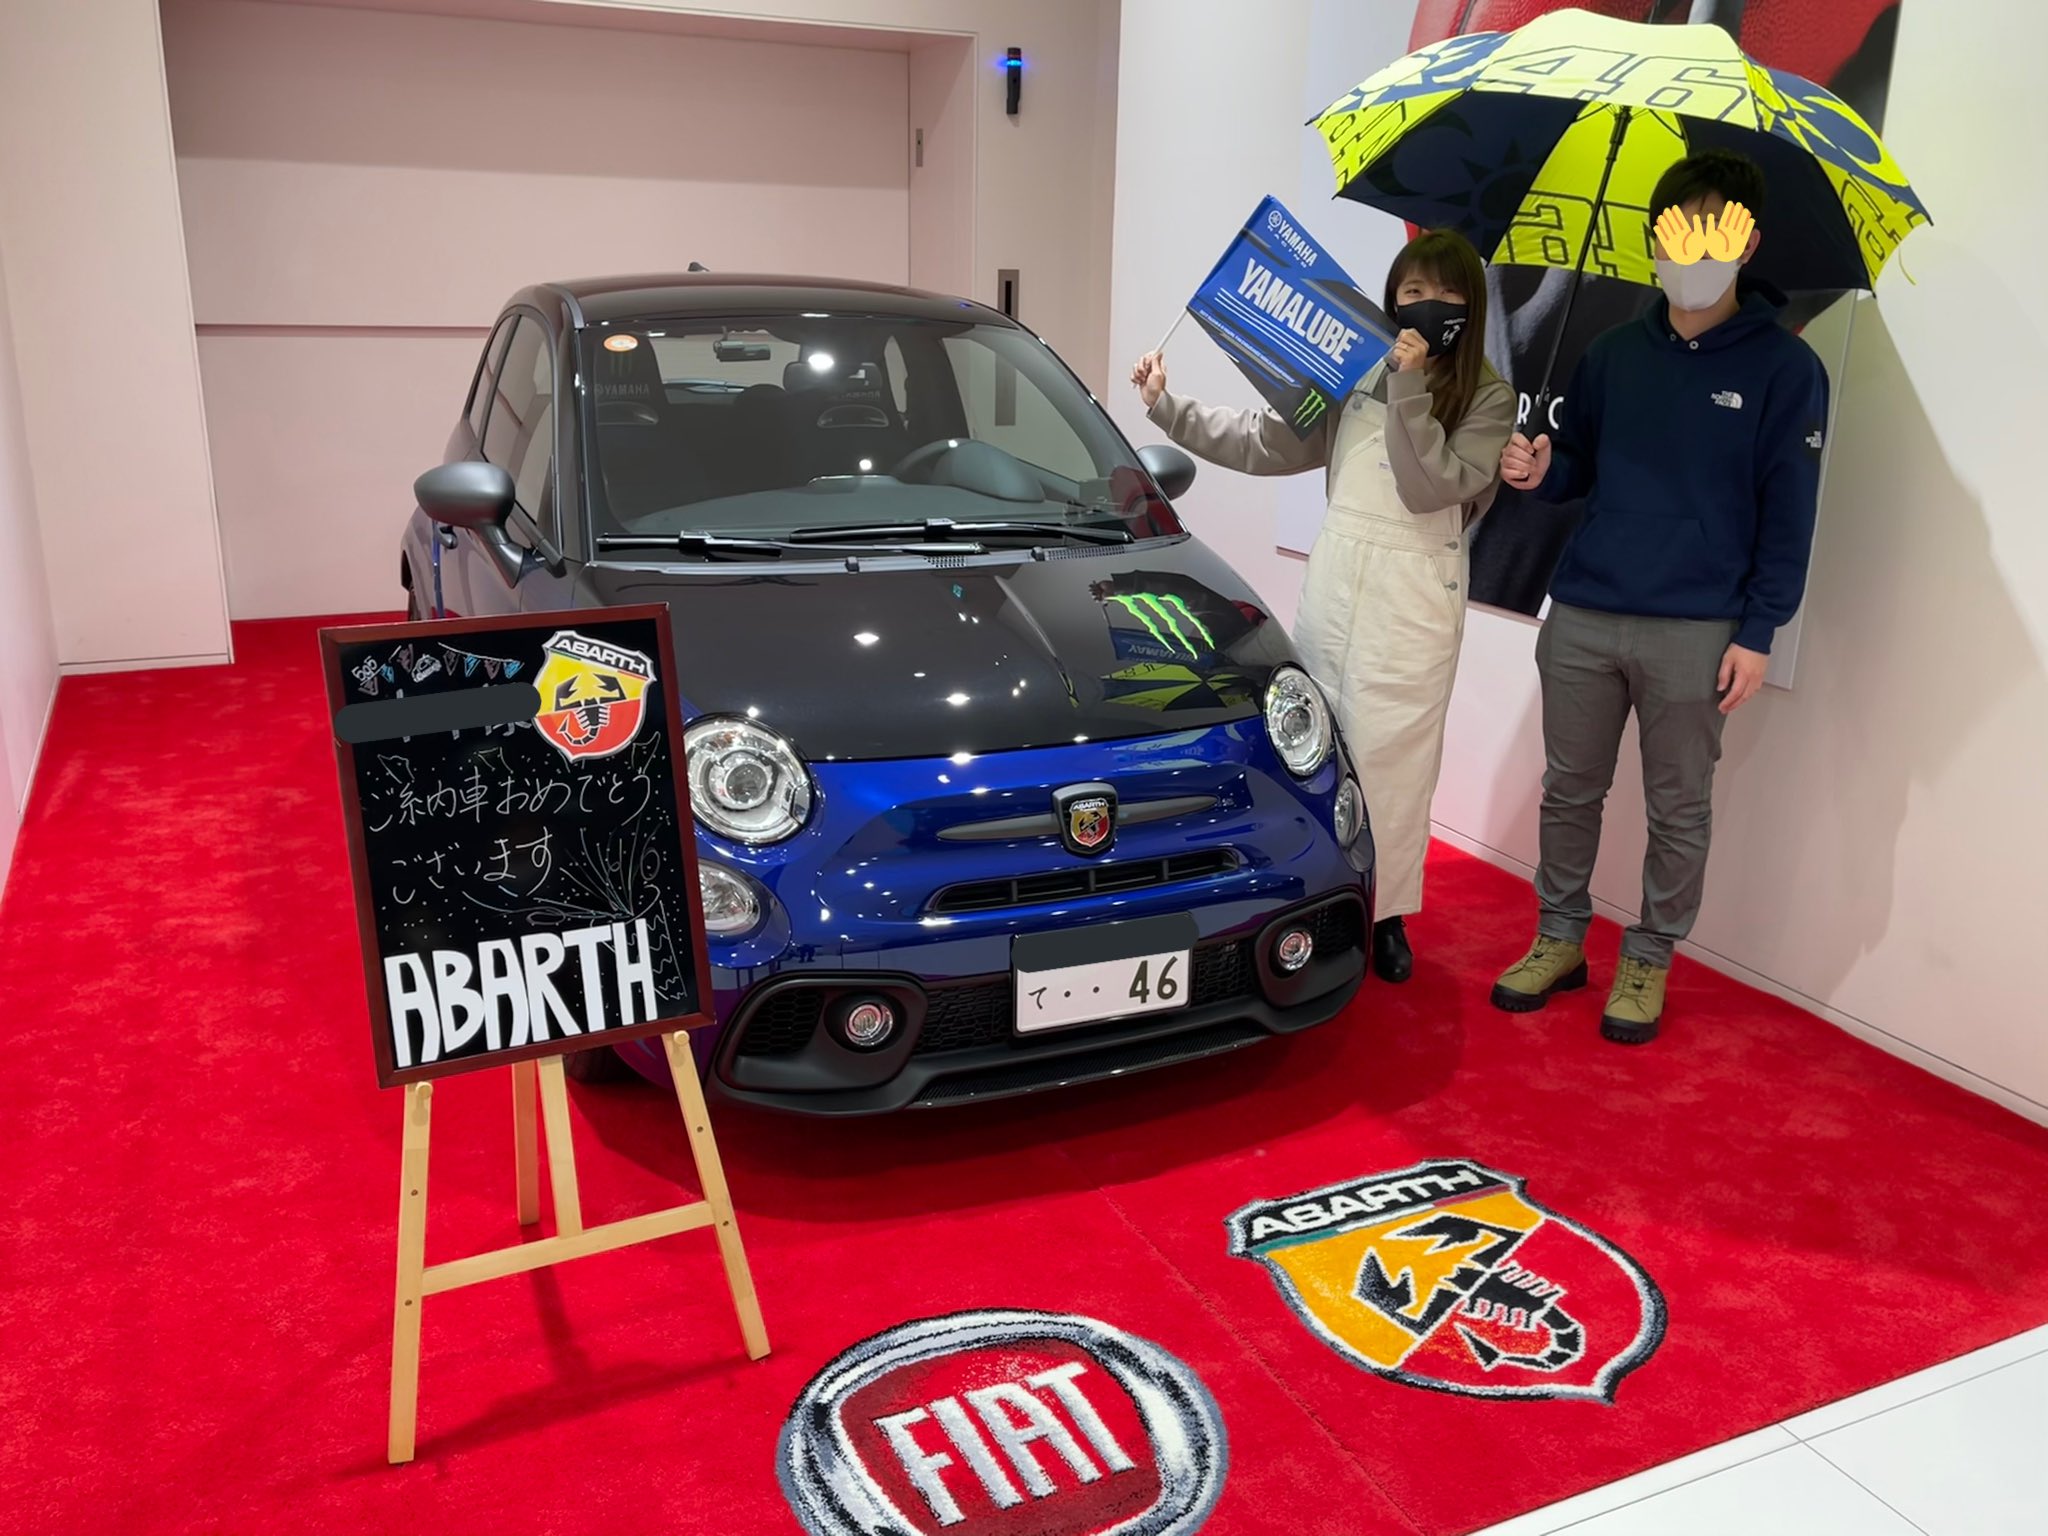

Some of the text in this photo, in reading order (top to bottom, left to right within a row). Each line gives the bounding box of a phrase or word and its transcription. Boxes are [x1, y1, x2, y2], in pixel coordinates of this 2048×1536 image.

[1477, 45, 1747, 121] 46
[1278, 220, 1319, 267] YAMAHA
[1237, 257, 1359, 366] YAMALUBE
[555, 639, 646, 674] ABARTH
[1073, 801, 1105, 810] ABARTH
[392, 826, 553, 904] ございます
[384, 918, 658, 1067] ABARTH
[1251, 1170, 1482, 1240] ABARTH
[873, 1361, 1136, 1527] FIAT
